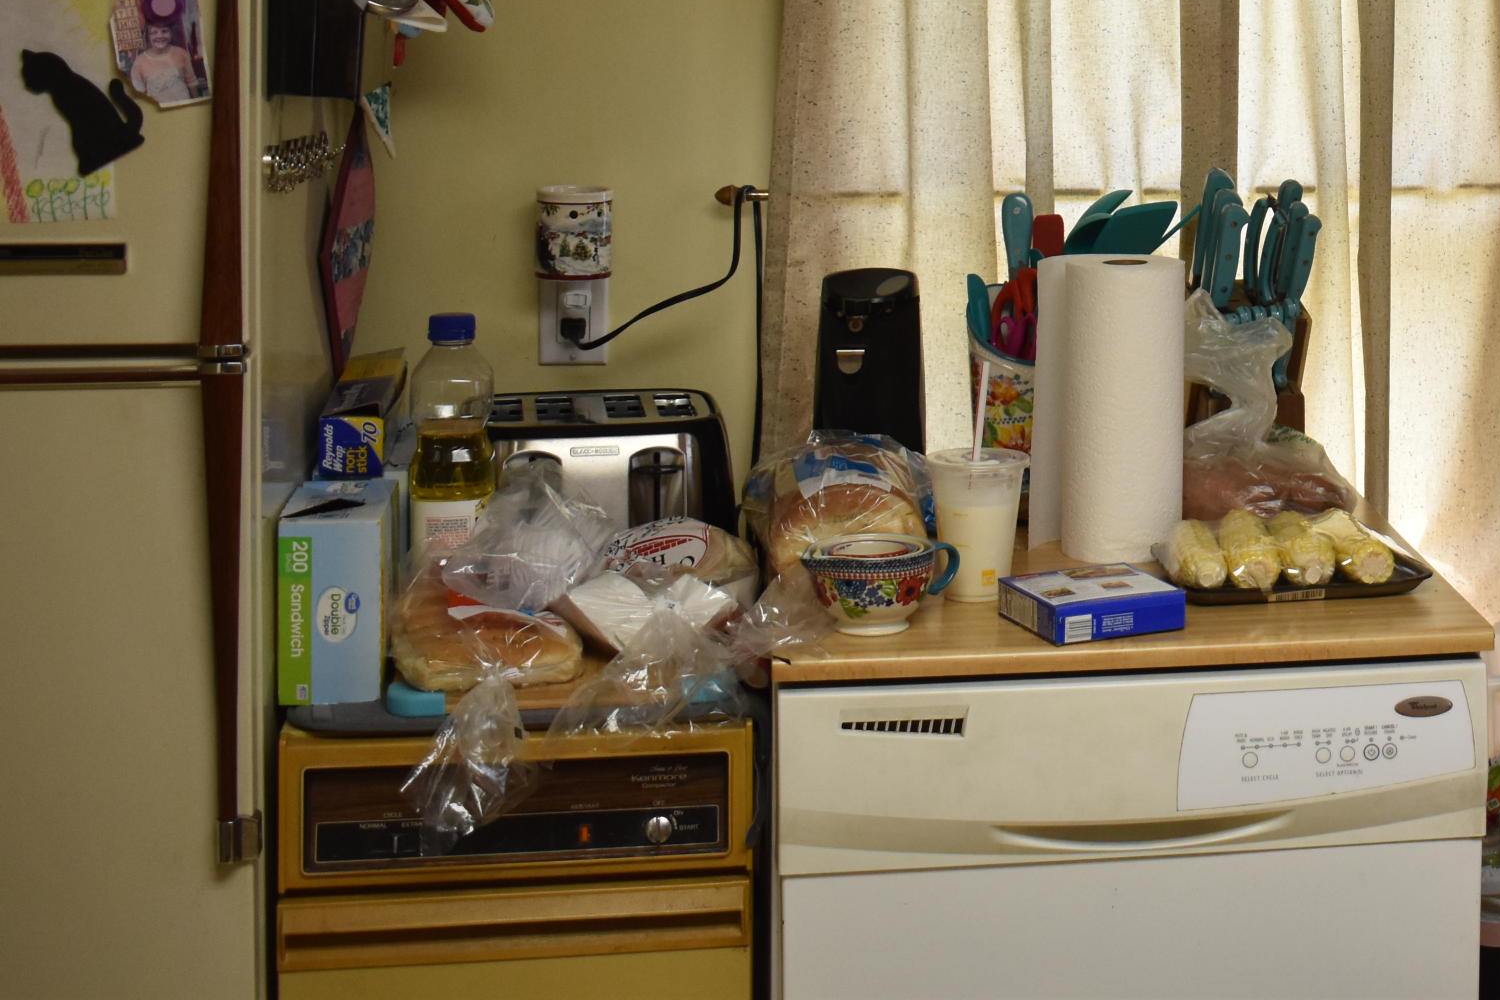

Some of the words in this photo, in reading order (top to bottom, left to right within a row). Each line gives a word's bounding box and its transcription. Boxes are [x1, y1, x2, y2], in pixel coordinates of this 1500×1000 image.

[321, 423, 335, 470] Reynolds
[361, 421, 378, 444] 70
[332, 444, 347, 473] Wrap
[357, 444, 369, 474] stick
[291, 540, 309, 574] 200
[290, 583, 305, 658] Sandwich
[330, 593, 342, 636] Double
[630, 773, 688, 783] Kenmore
